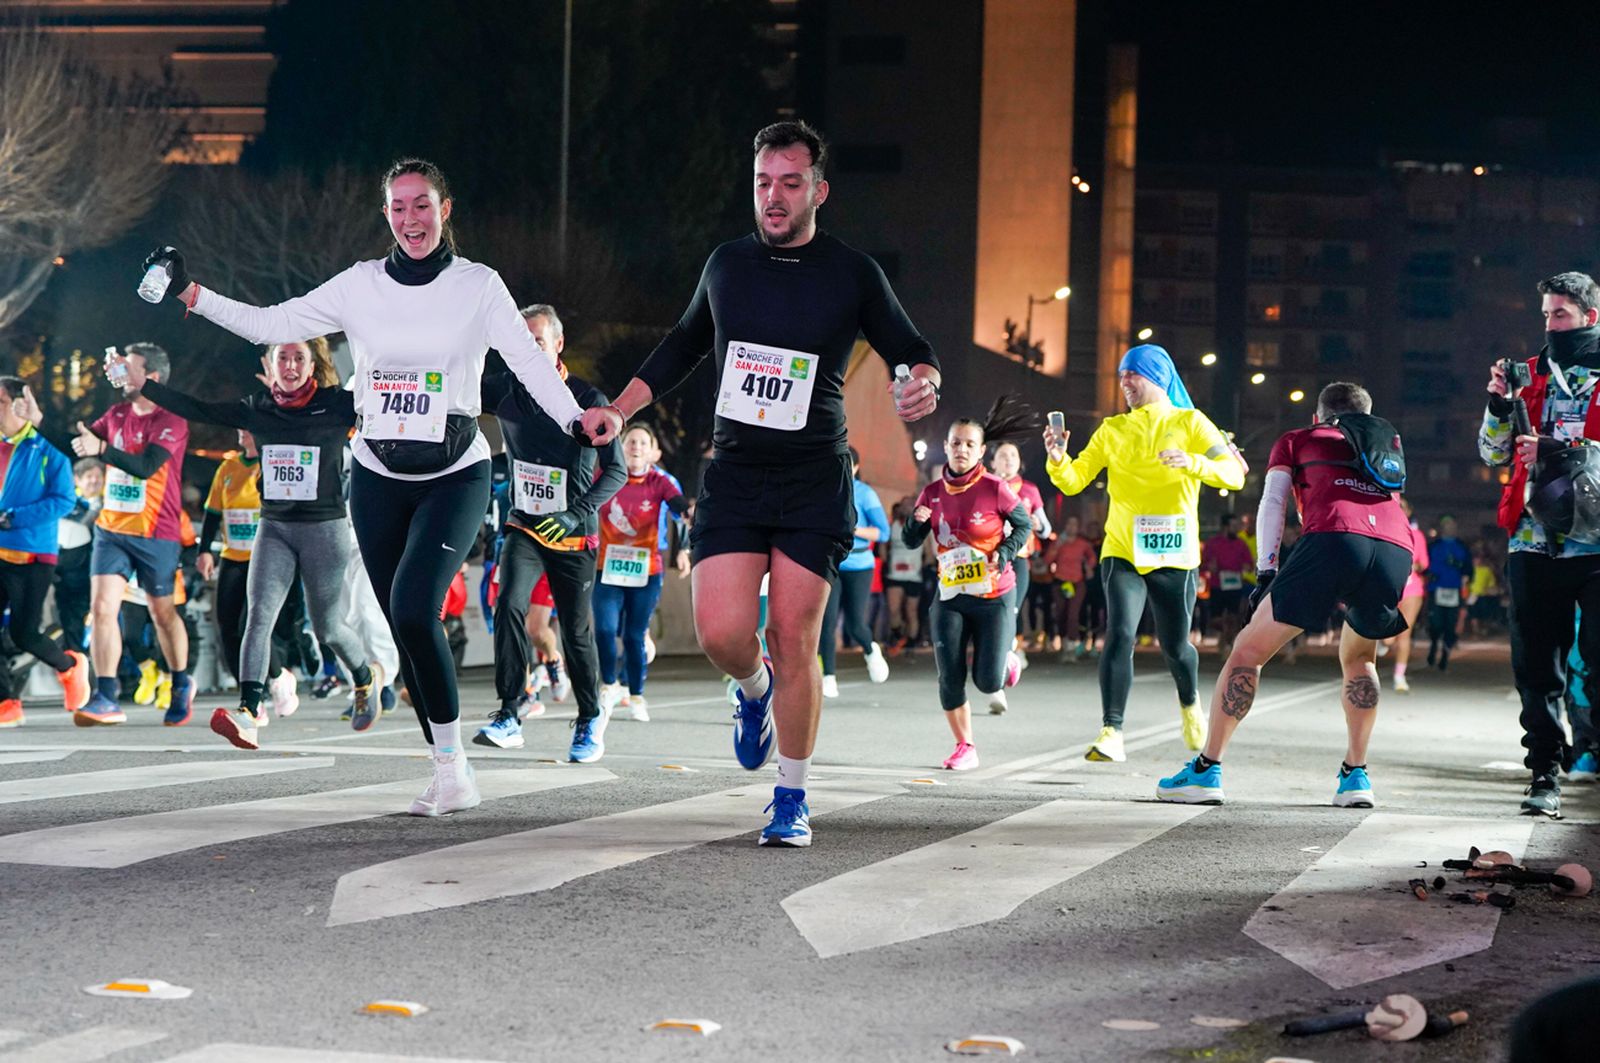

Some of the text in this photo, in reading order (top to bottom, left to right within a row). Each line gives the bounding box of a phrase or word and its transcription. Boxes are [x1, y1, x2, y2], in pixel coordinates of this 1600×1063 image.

[735, 360, 753, 370] SAN
[746, 353, 773, 364] NOCHE
[773, 357, 784, 366] DE
[382, 373, 407, 381] NOCHE
[409, 374, 418, 382] DE
[373, 382, 389, 391] SAN
[741, 373, 793, 402] 4107
[381, 392, 430, 415] 7480
[273, 466, 304, 482] 7663
[109, 484, 140, 498] 13595
[523, 481, 554, 499] 4756
[1334, 478, 1380, 492] calde
[1143, 533, 1182, 549] 13120
[610, 560, 642, 574] 13470
[948, 563, 982, 582] 331
